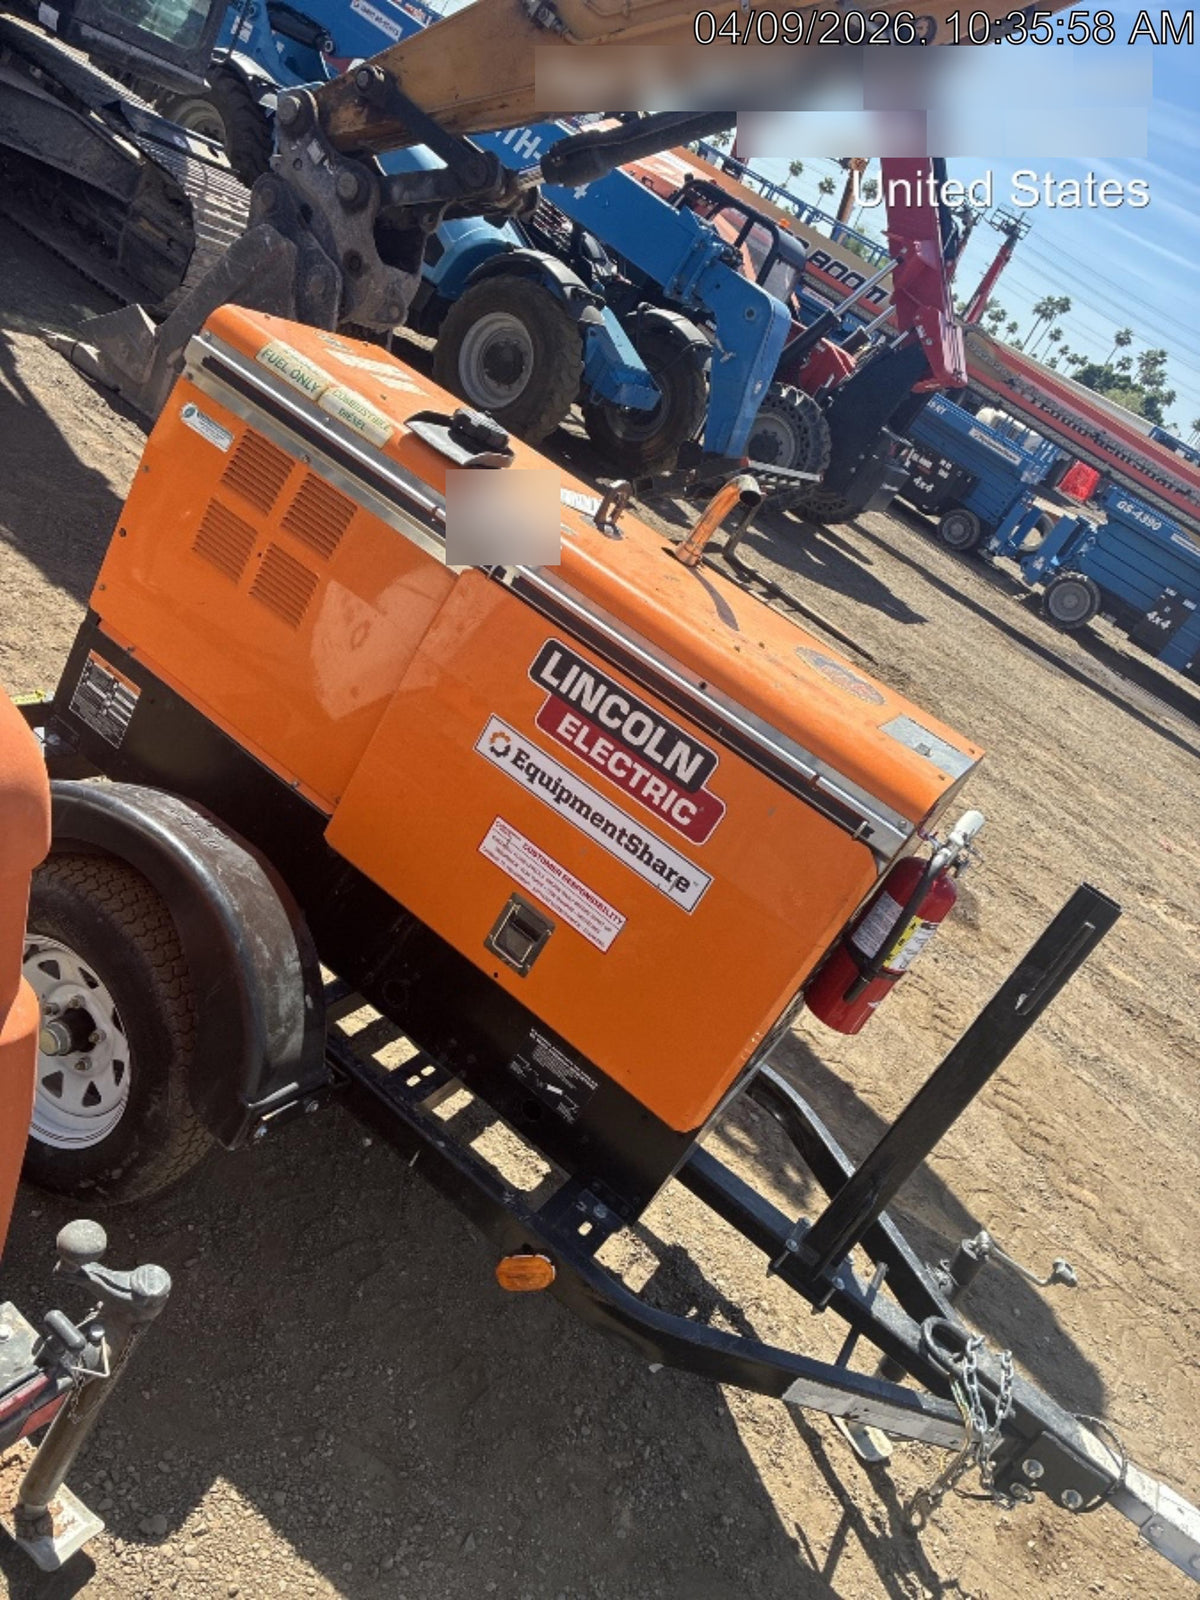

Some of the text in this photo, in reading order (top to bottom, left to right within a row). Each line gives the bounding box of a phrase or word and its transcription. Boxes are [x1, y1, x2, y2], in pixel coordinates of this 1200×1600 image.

[261, 348, 288, 373] FUEL
[289, 369, 320, 393] ONLY
[913, 476, 934, 493] 4x4
[1116, 501, 1162, 530] GS-4390
[1147, 611, 1171, 629] 4x4
[540, 650, 704, 784] LINCOLN
[556, 712, 698, 826] ELECTRIC
